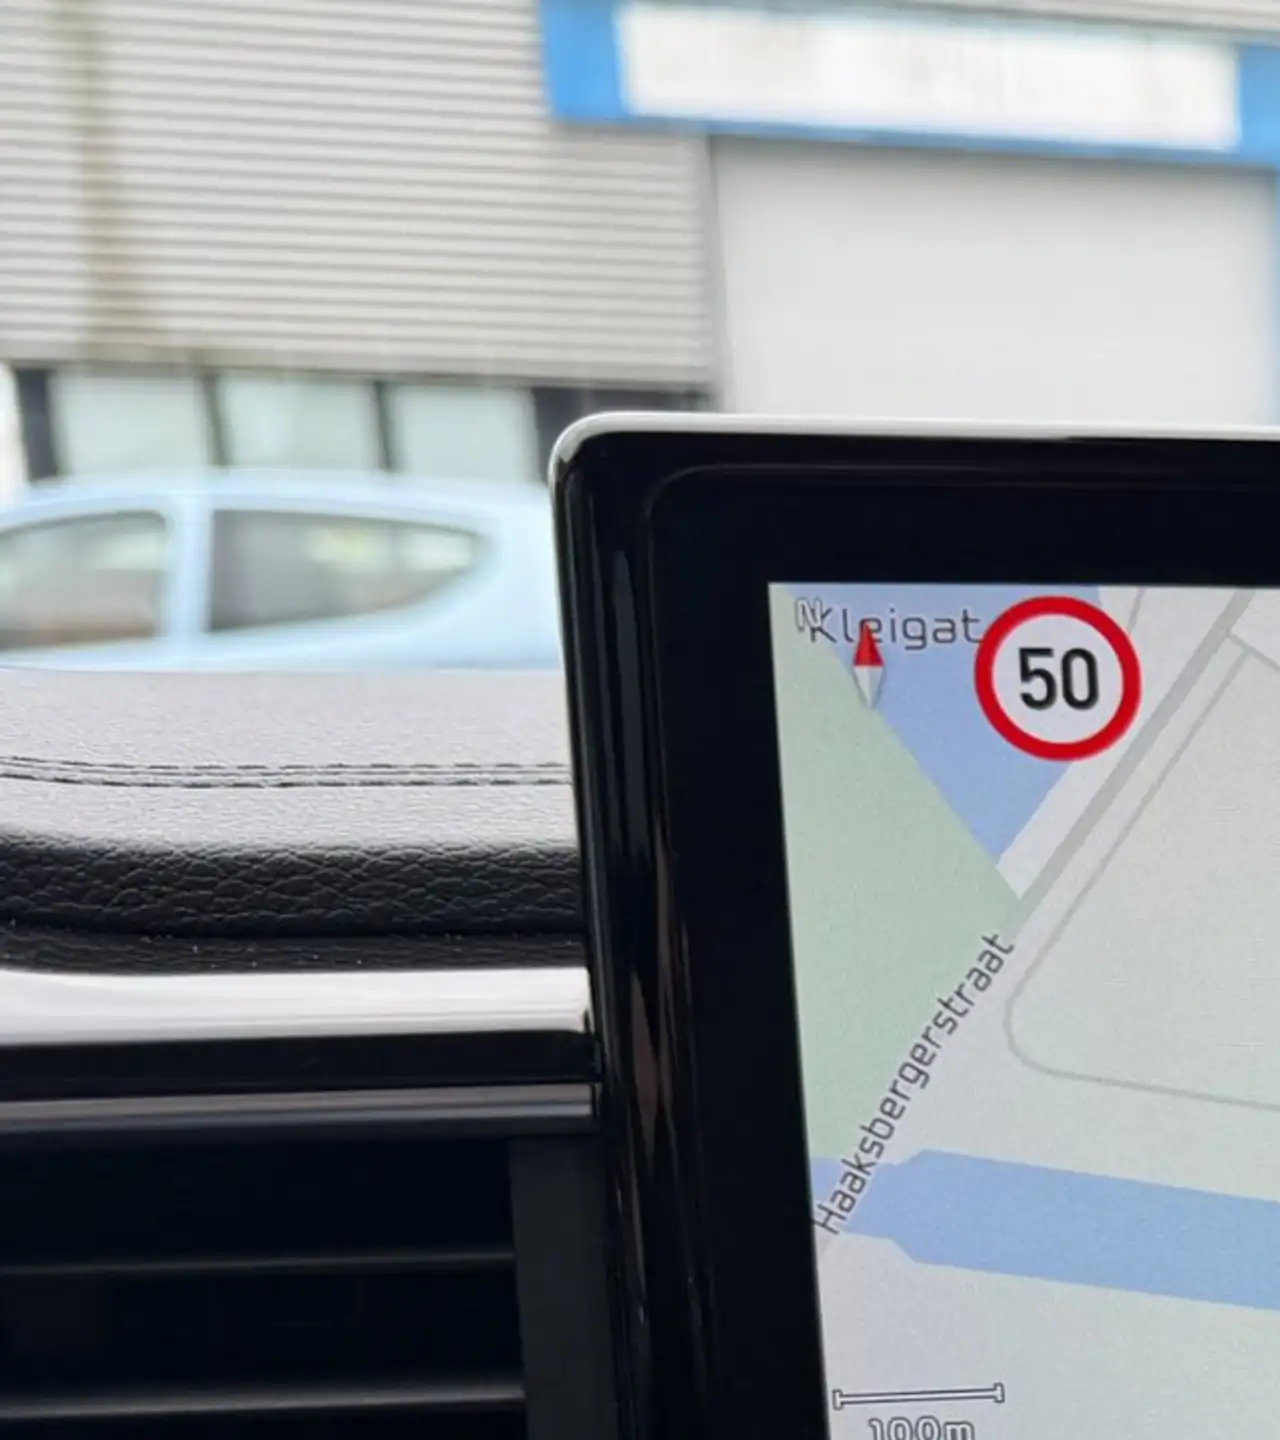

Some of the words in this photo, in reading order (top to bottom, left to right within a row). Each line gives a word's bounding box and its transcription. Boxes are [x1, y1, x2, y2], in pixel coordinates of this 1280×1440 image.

[810, 606, 984, 650] Kleigat
[1018, 646, 1099, 710] 50
[810, 933, 1014, 1234] Haaksbergerstraat
